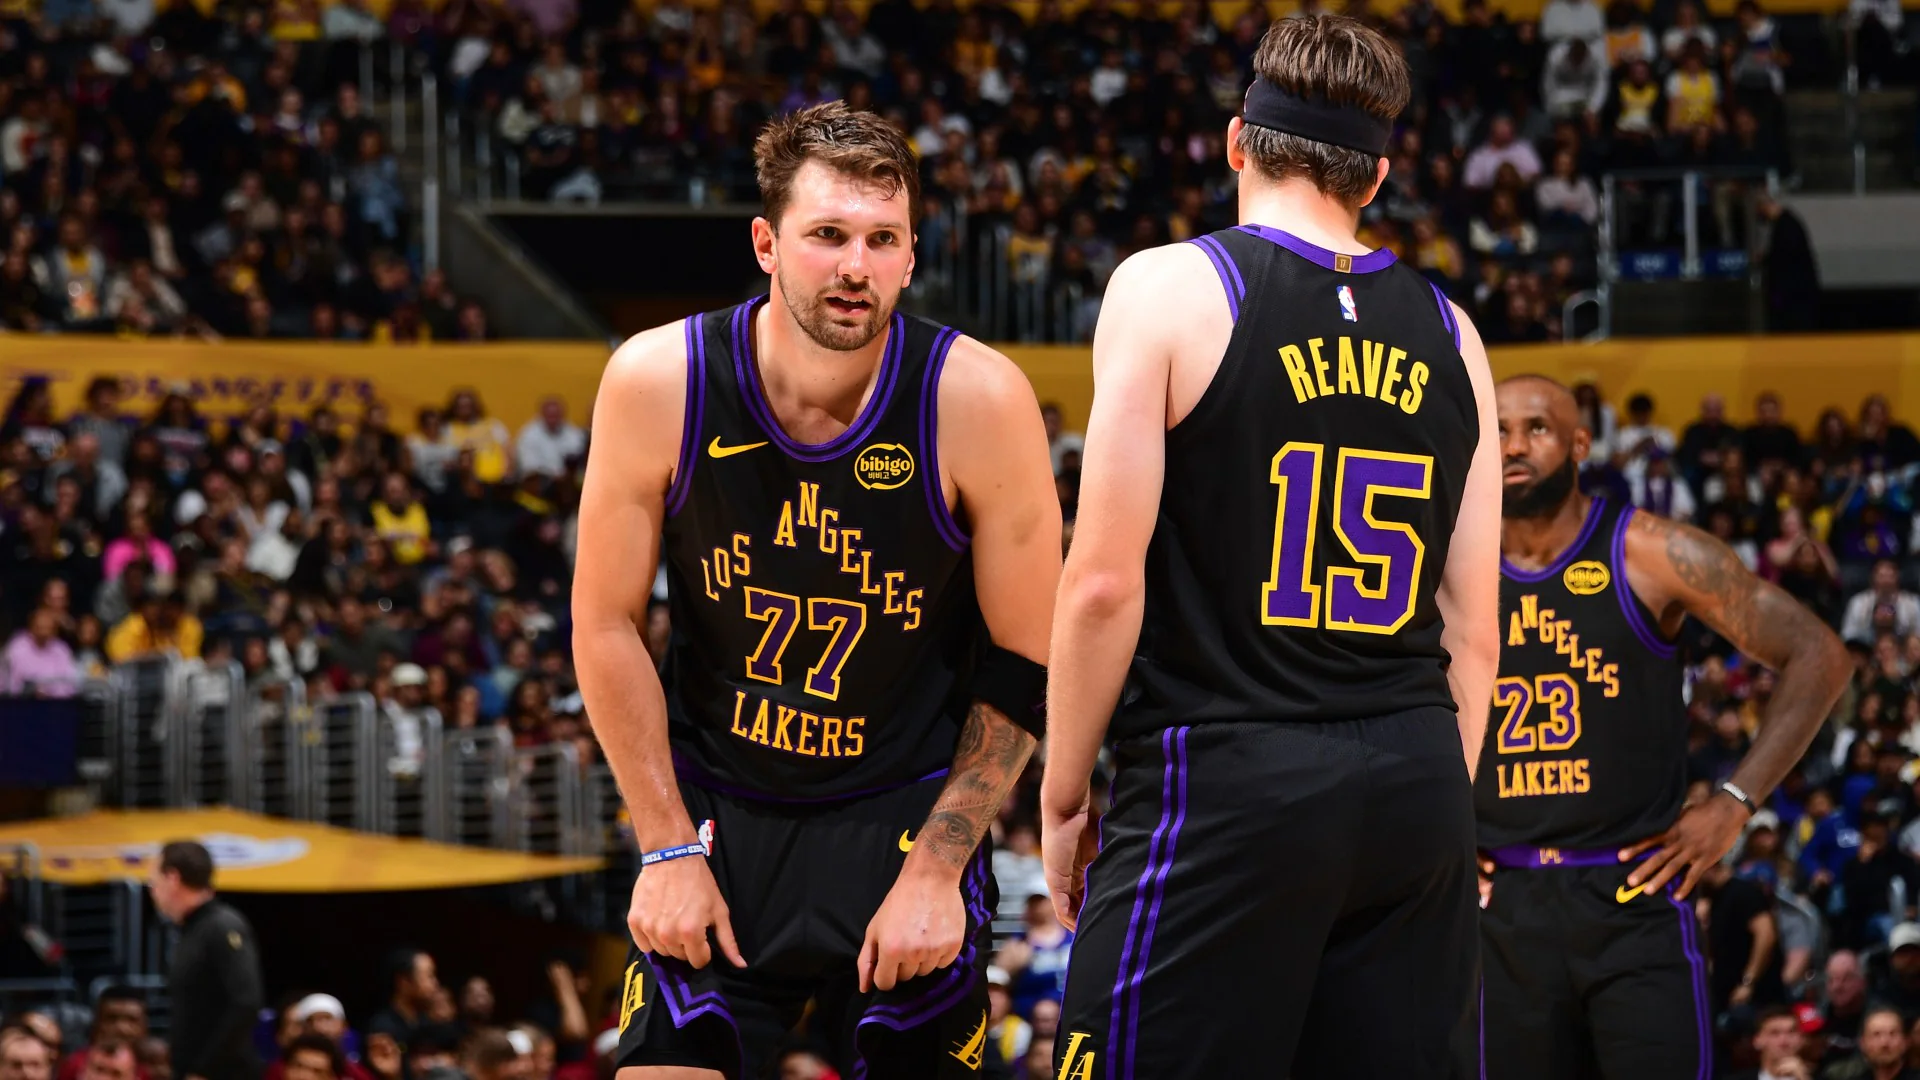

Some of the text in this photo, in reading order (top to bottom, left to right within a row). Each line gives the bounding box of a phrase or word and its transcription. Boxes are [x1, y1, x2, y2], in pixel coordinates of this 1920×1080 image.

[1278, 336, 1430, 415] REAVES
[860, 455, 911, 476] bibigo
[868, 472, 890, 480] 비비고
[701, 481, 925, 631] LOS ANGELES
[1261, 441, 1434, 635] 15
[743, 586, 867, 701] 77
[1508, 594, 1620, 698] ANGELES
[731, 690, 866, 757] LAKERS
[1494, 673, 1582, 755] 23
[1497, 759, 1591, 798] LAKERS
[619, 961, 645, 1036] LA
